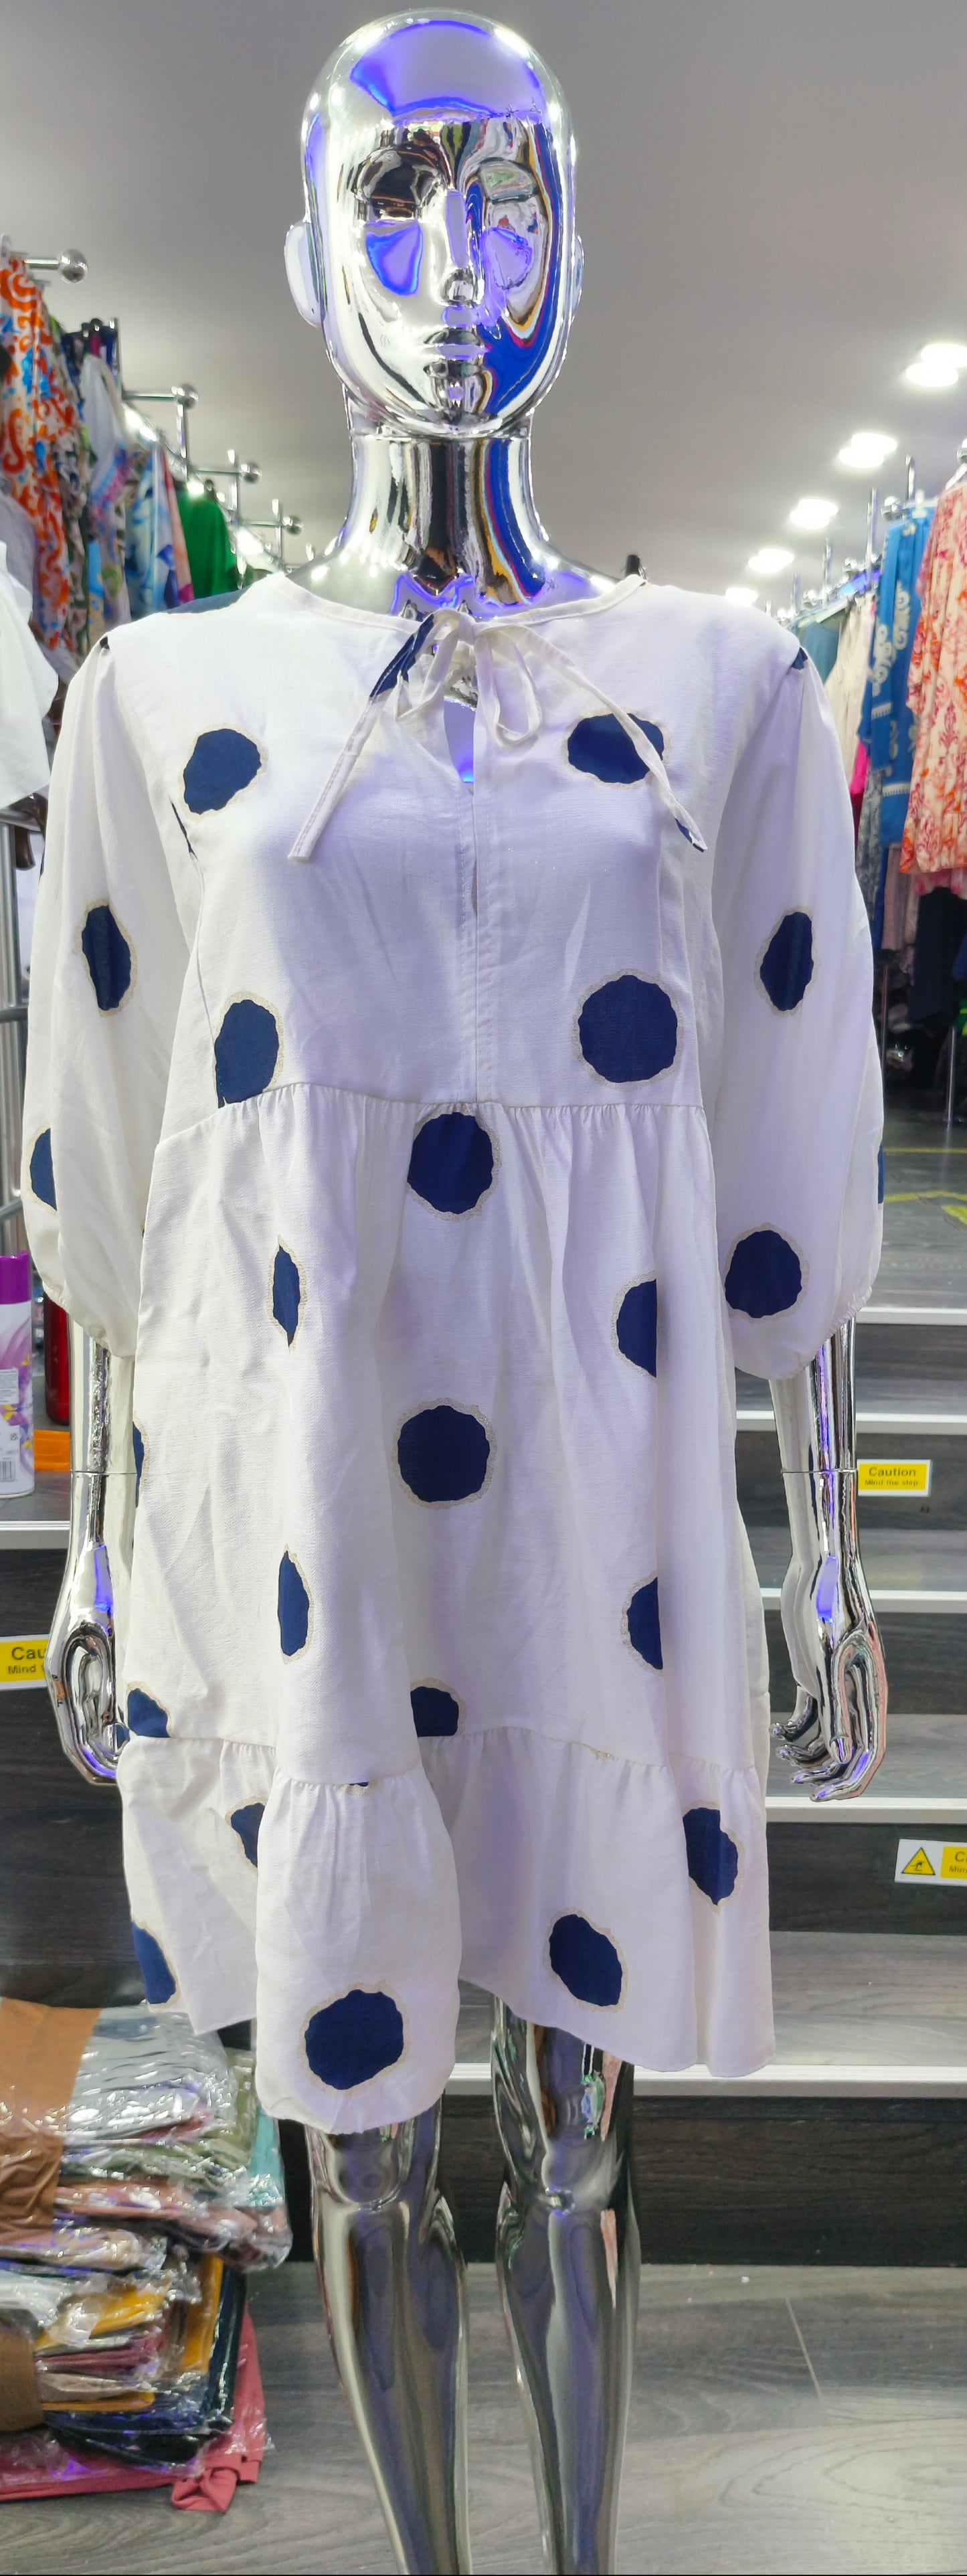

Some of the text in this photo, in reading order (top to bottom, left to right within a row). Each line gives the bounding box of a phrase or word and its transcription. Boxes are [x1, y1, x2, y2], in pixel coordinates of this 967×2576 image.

[869, 1466, 916, 1476] Caution
[8, 1664, 36, 1674] Mind
[955, 1851, 967, 1862] C
[949, 1865, 967, 1873] Min
